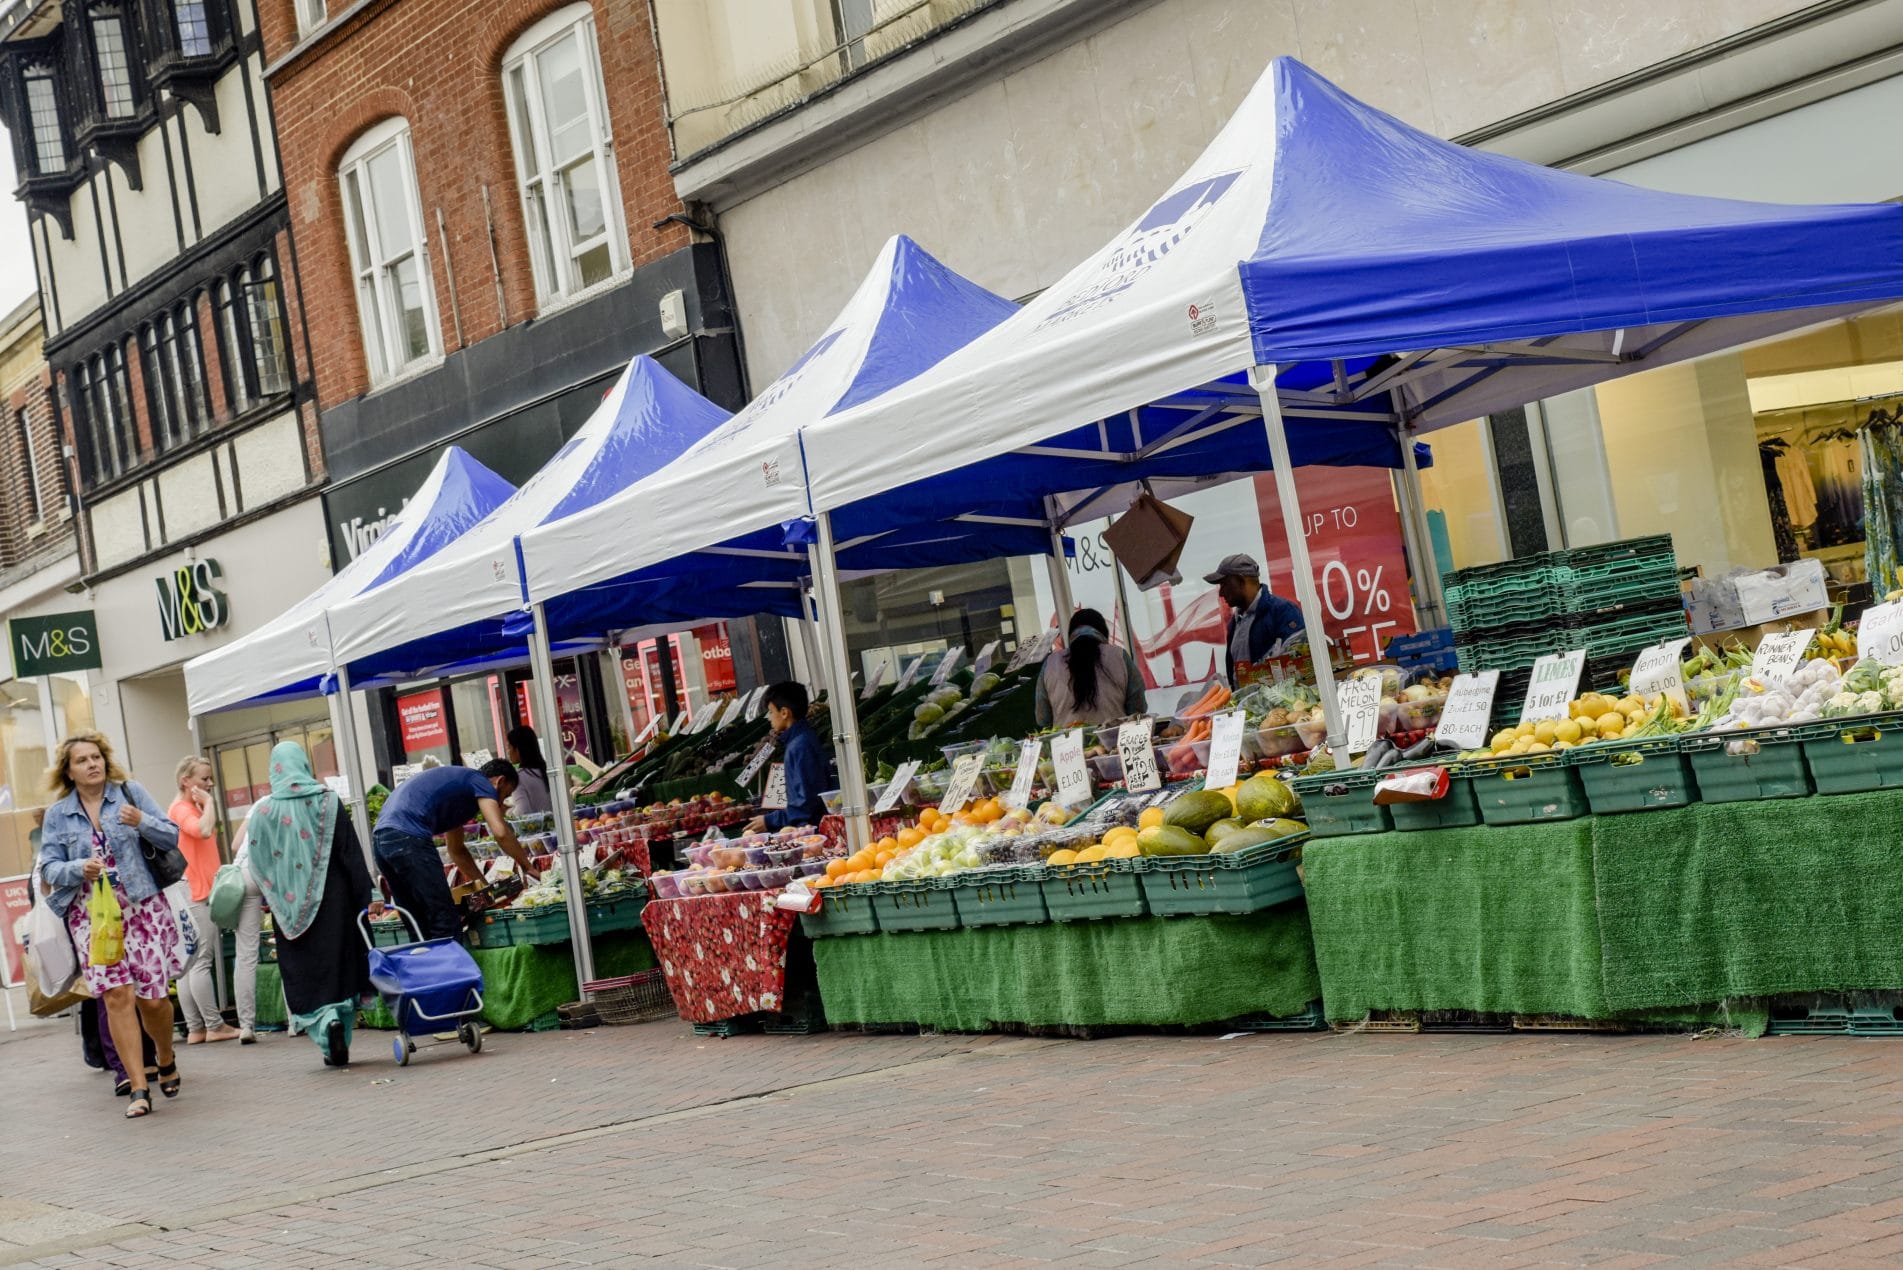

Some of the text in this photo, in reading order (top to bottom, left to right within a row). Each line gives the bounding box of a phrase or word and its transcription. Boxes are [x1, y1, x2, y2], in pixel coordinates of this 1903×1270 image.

[1331, 506, 1357, 530] TO
[155, 558, 230, 642] M&S
[1322, 560, 1391, 621] 0%
[1866, 607, 1903, 630] Garli
[21, 626, 90, 661] M&S
[1758, 641, 1796, 655] RUNNER
[623, 659, 640, 671] Ge
[1636, 653, 1673, 673] lemon
[1767, 654, 1793, 665] BEANS
[1536, 657, 1578, 683] LIMES
[1344, 679, 1376, 696] FROG
[1341, 695, 1375, 709] MELON
[1529, 696, 1537, 709] 5
[1555, 690, 1568, 704] £1
[1459, 724, 1482, 734] EACH
[1061, 769, 1083, 789] £1.00
